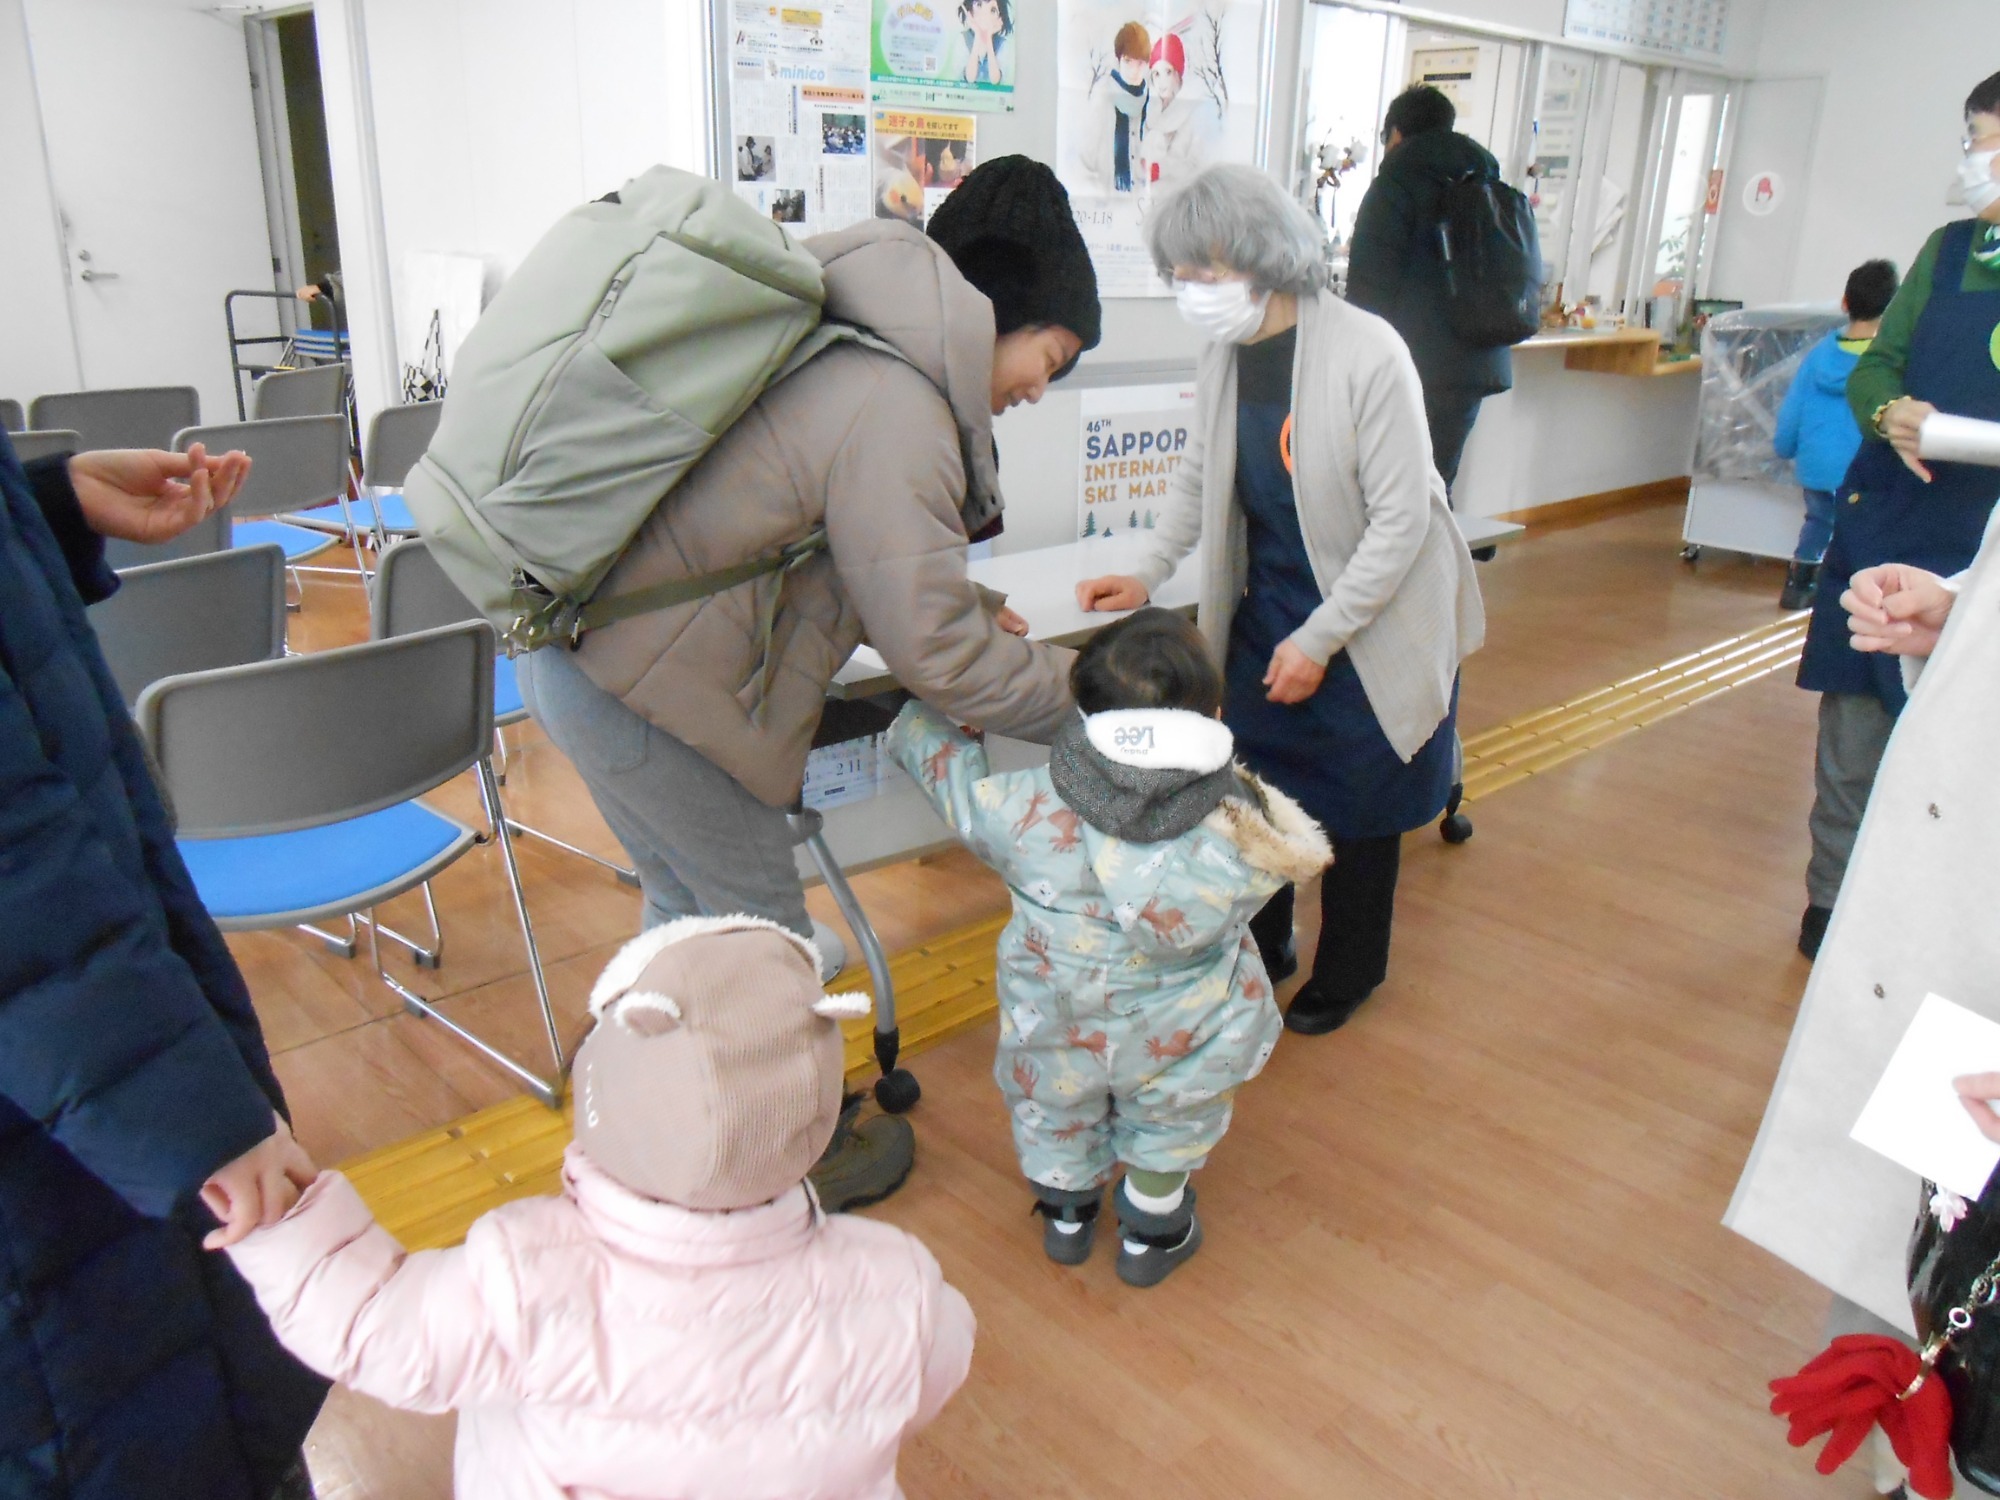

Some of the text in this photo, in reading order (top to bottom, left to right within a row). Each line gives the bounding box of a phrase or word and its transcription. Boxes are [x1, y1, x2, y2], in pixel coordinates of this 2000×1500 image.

[780, 65, 825, 81] minico
[1086, 419, 1112, 433] 46TH
[1086, 427, 1188, 460] SAPPOR
[1084, 479, 1168, 505] SKI MAR
[1114, 725, 1155, 749] Lee
